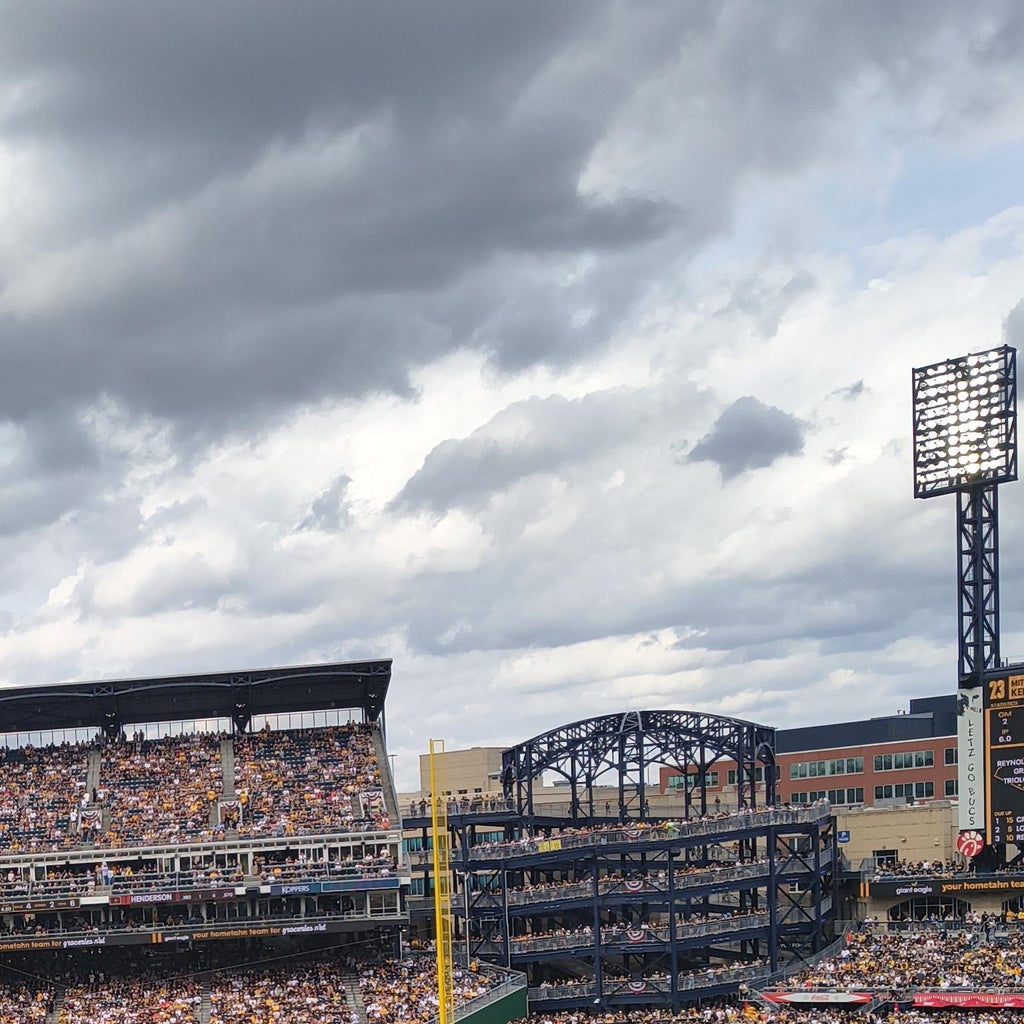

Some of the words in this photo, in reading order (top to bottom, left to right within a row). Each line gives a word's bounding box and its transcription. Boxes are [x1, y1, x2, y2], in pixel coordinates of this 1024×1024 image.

[989, 680, 1005, 699] 23
[968, 764, 975, 781] GO
[281, 885, 310, 894] KOPPERS
[914, 886, 932, 894] eagle
[942, 884, 962, 892] your
[964, 881, 1008, 890] hometahn
[131, 893, 172, 903] HENDERSON
[210, 929, 248, 938] hometahn
[282, 925, 313, 936] groceries
[63, 938, 93, 949] groceries
